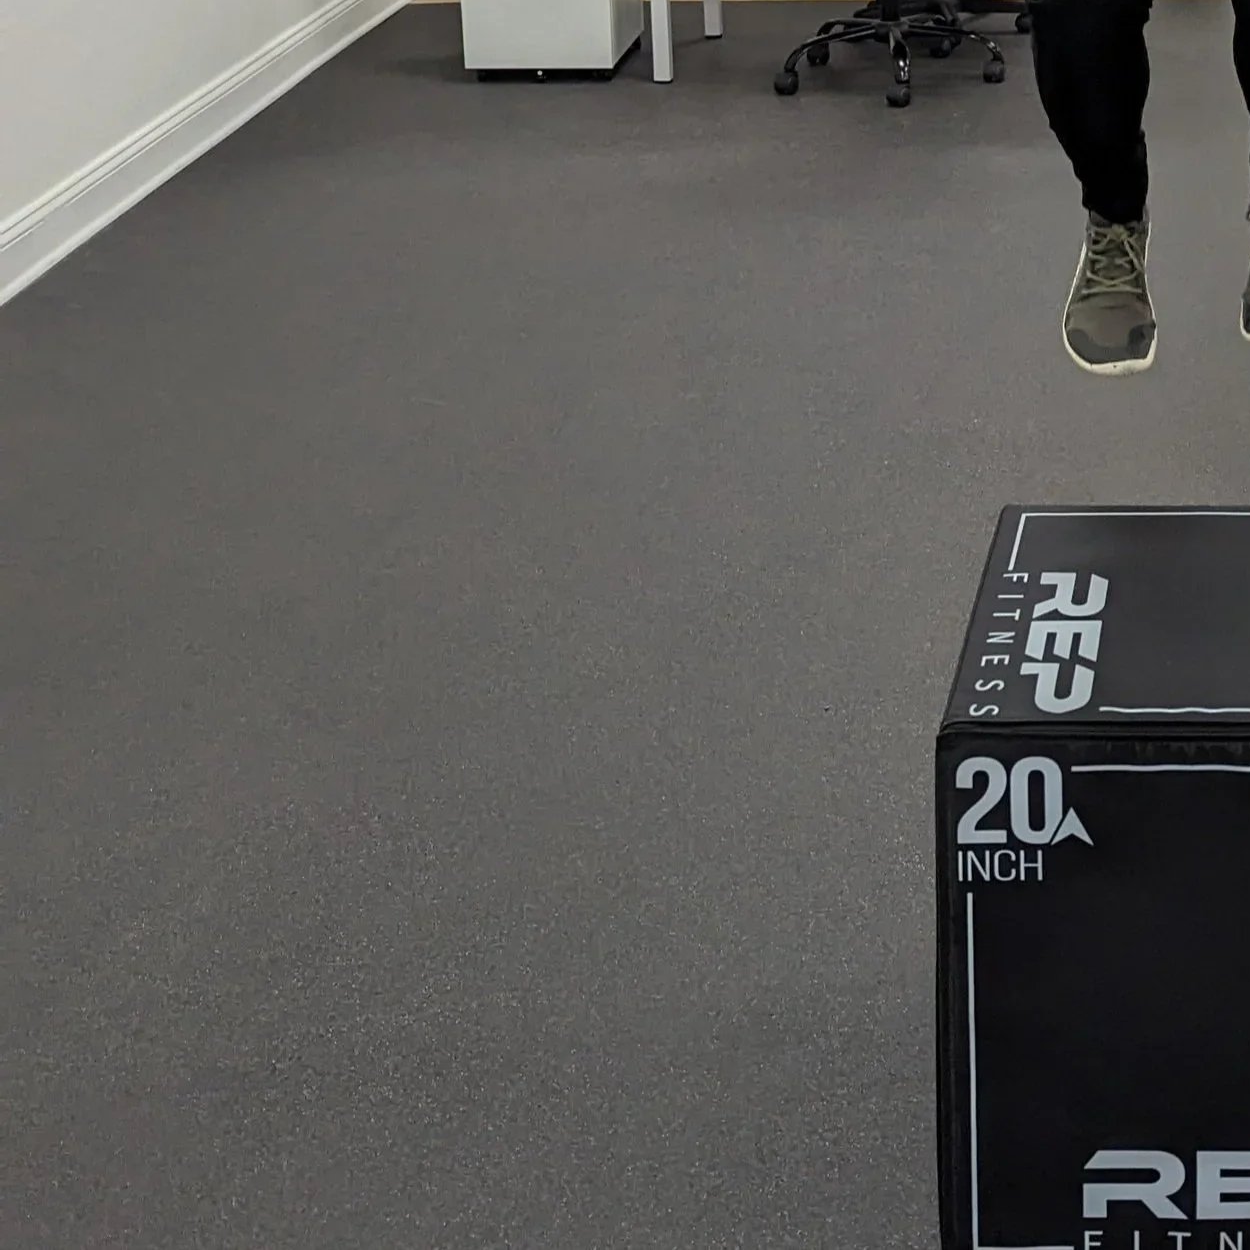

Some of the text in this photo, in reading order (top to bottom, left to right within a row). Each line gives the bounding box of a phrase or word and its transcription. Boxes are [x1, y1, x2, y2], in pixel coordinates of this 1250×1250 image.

[969, 573, 1029, 716] FITNESS
[1020, 572, 1109, 714] REP
[955, 756, 1063, 845] 20
[957, 849, 1043, 882] INCH
